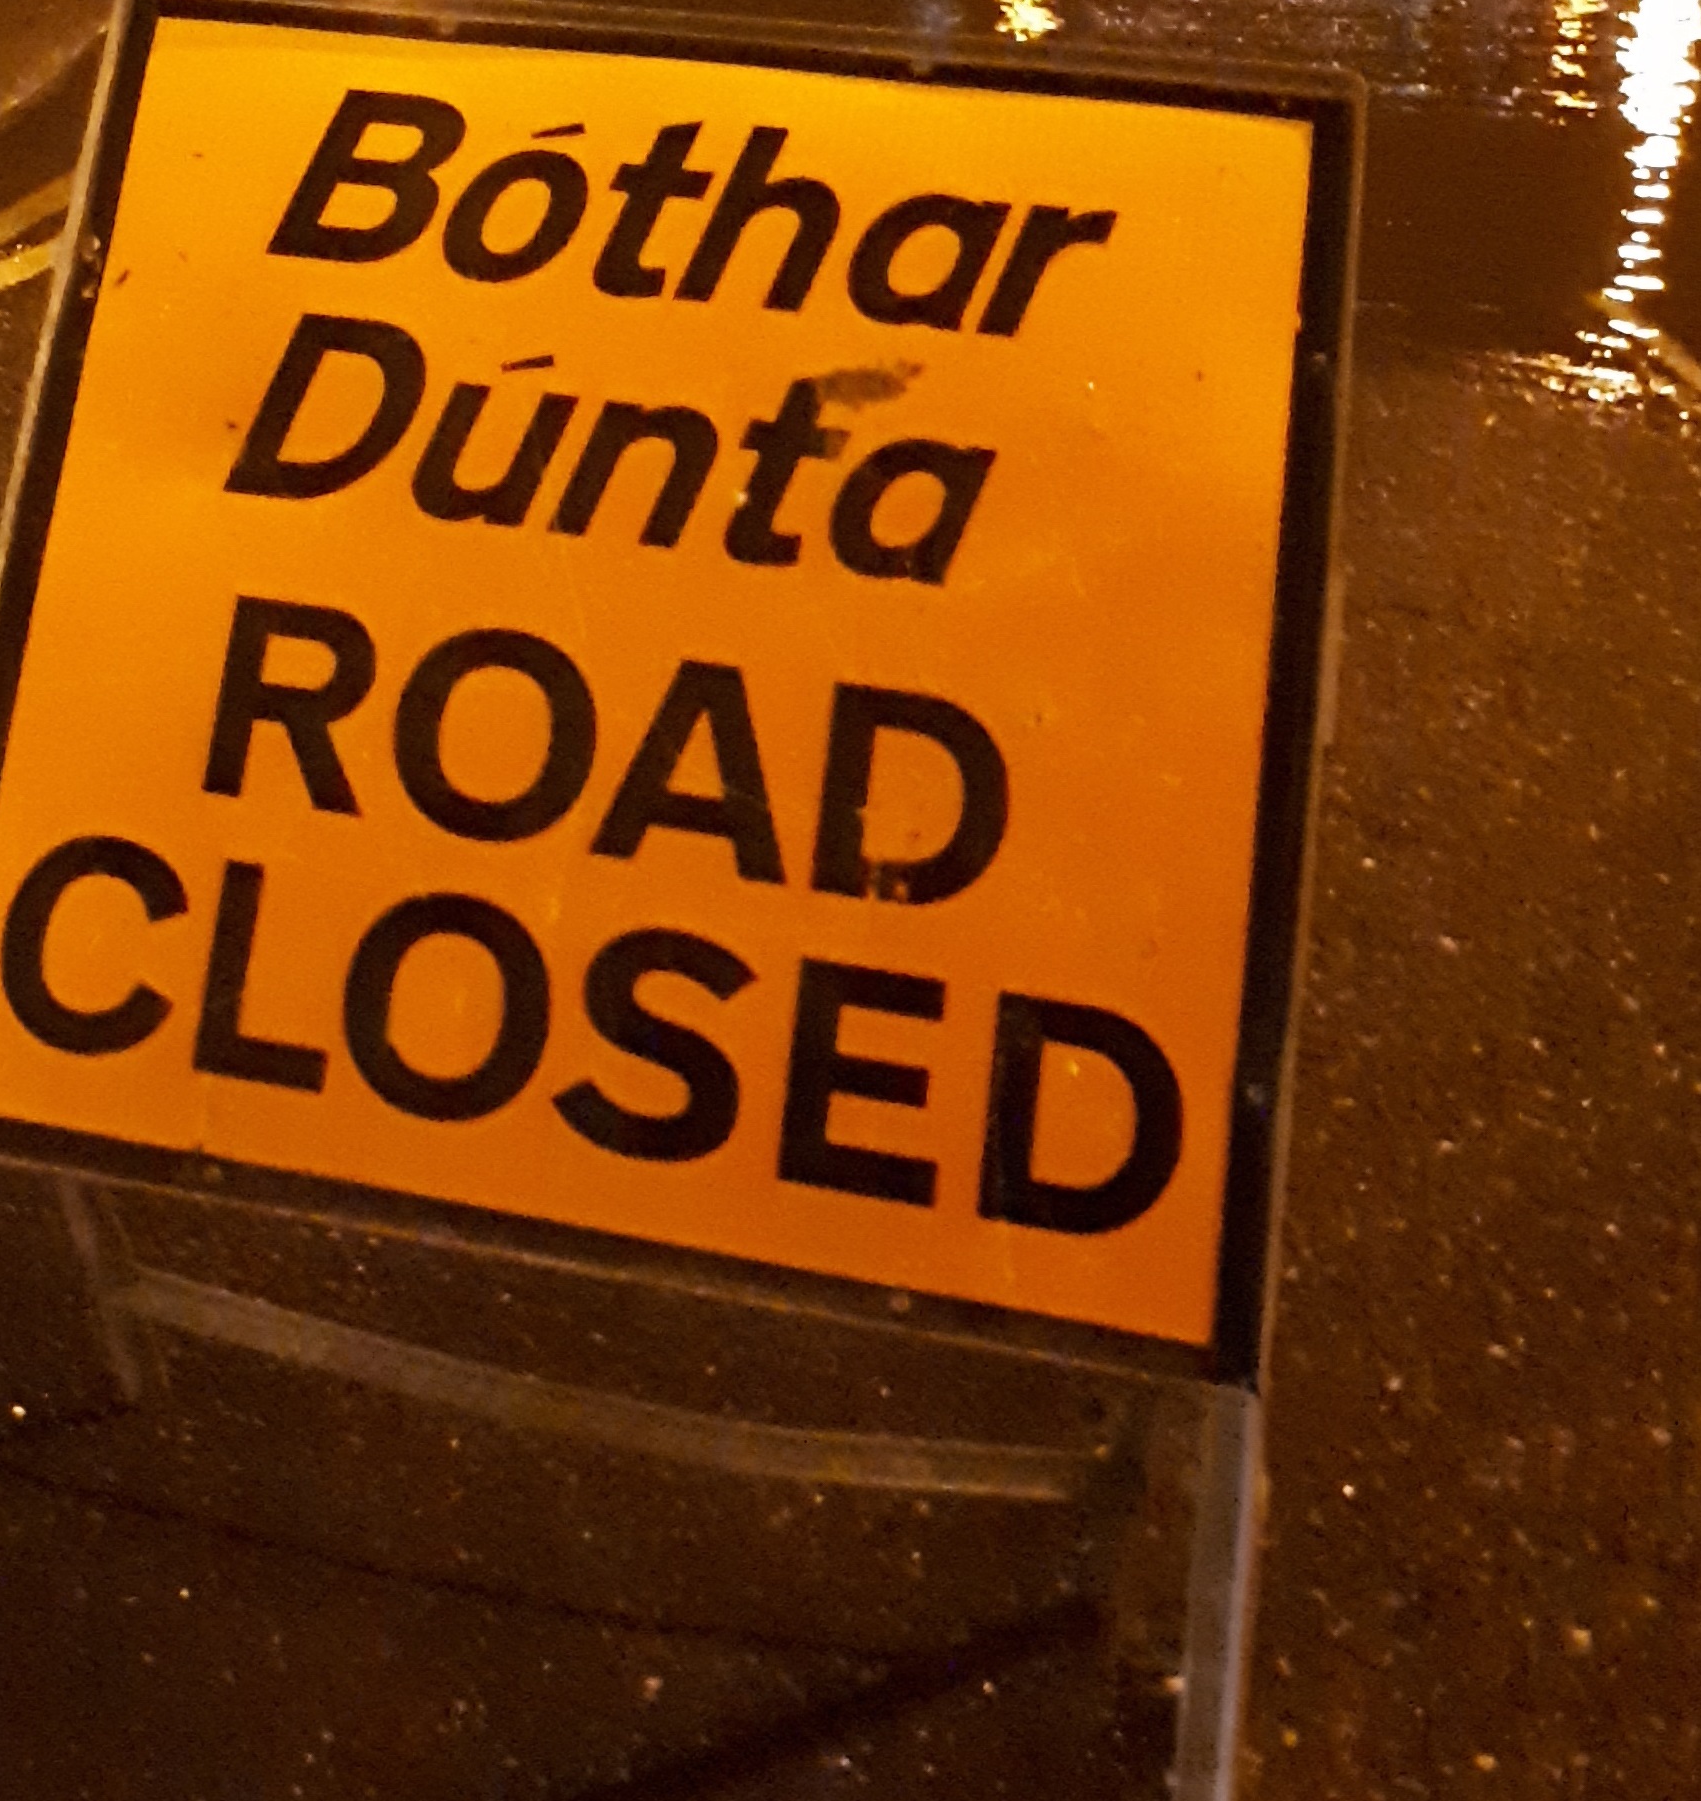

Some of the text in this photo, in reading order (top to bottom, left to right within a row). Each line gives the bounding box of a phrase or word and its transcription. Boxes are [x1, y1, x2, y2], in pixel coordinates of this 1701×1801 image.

[268, 88, 1113, 336] Bóthar
[222, 312, 998, 587] Dúnta
[202, 597, 1011, 905] ROAD
[0, 835, 1184, 1236] CLOSED
